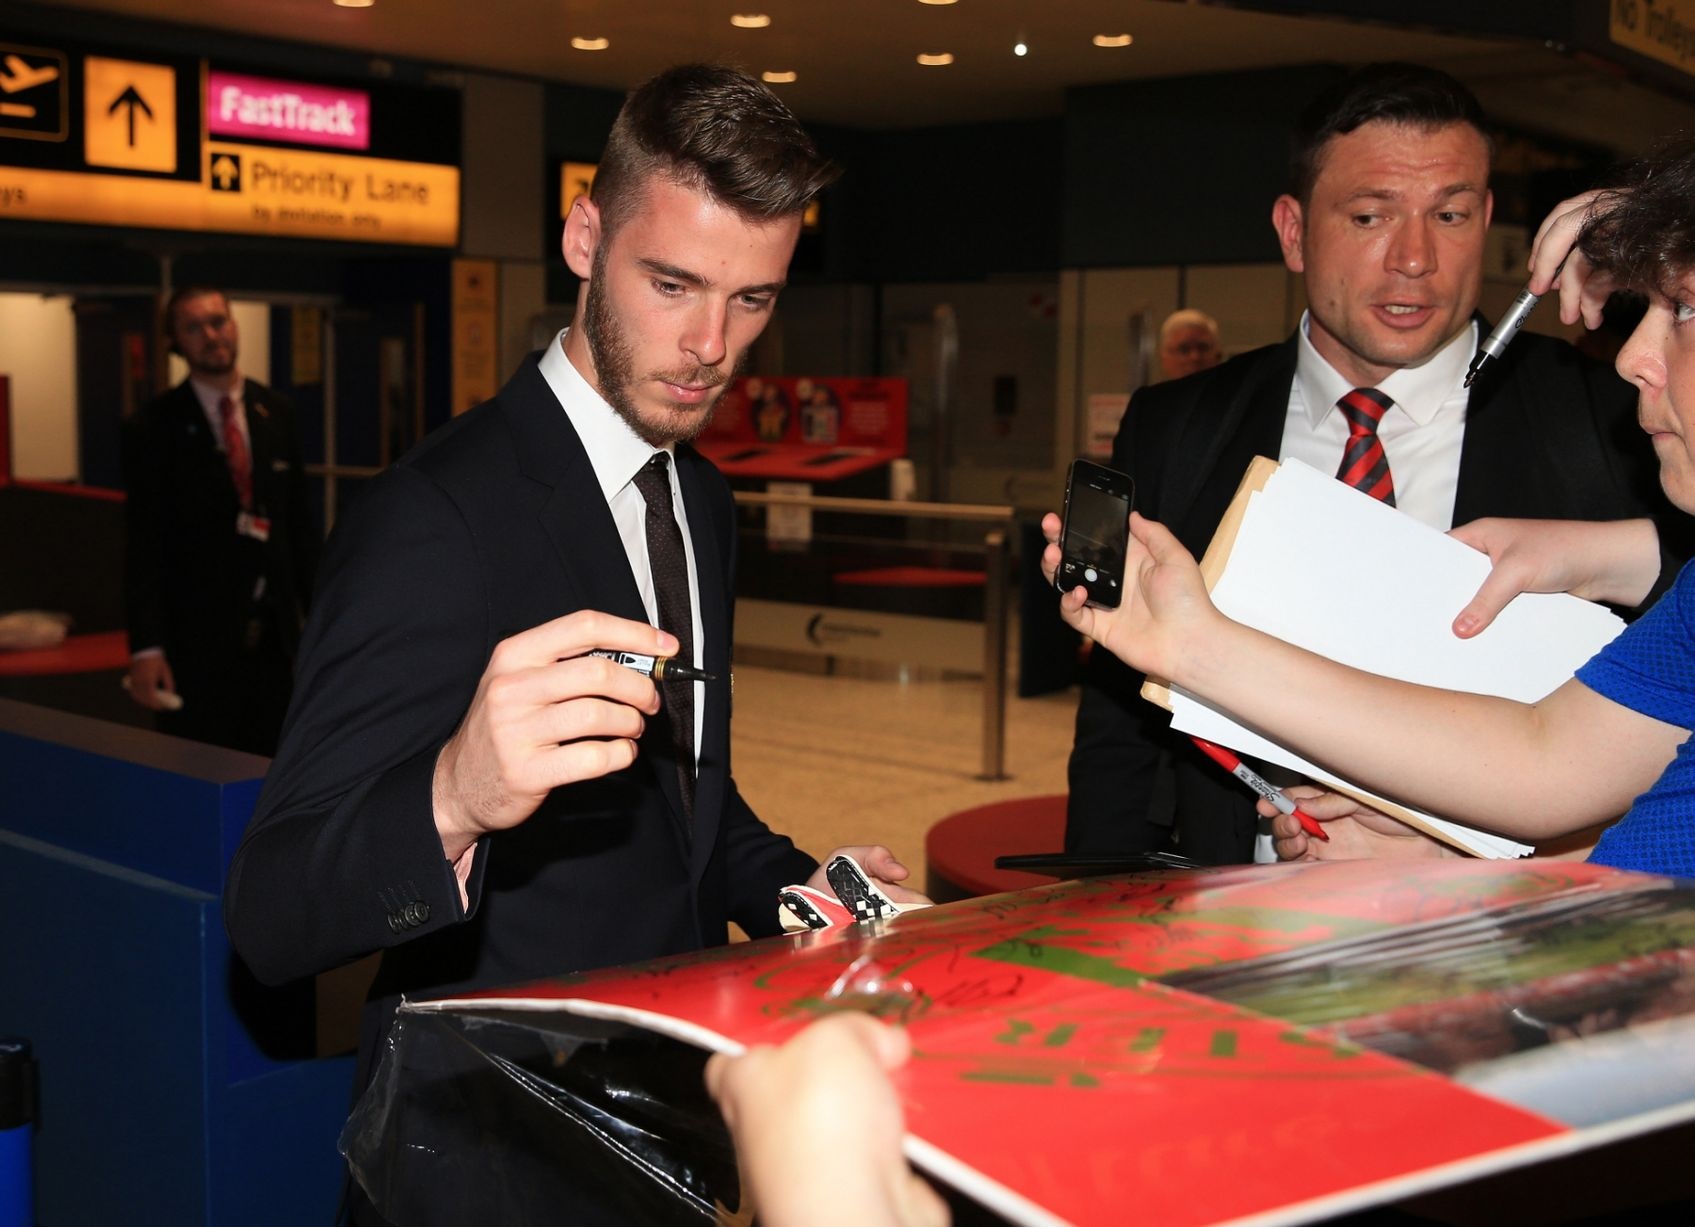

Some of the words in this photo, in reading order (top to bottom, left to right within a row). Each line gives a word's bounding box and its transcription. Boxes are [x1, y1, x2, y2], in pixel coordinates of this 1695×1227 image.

[219, 85, 356, 137] FastTrack
[251, 160, 354, 204] Priority
[365, 173, 429, 205] Lane
